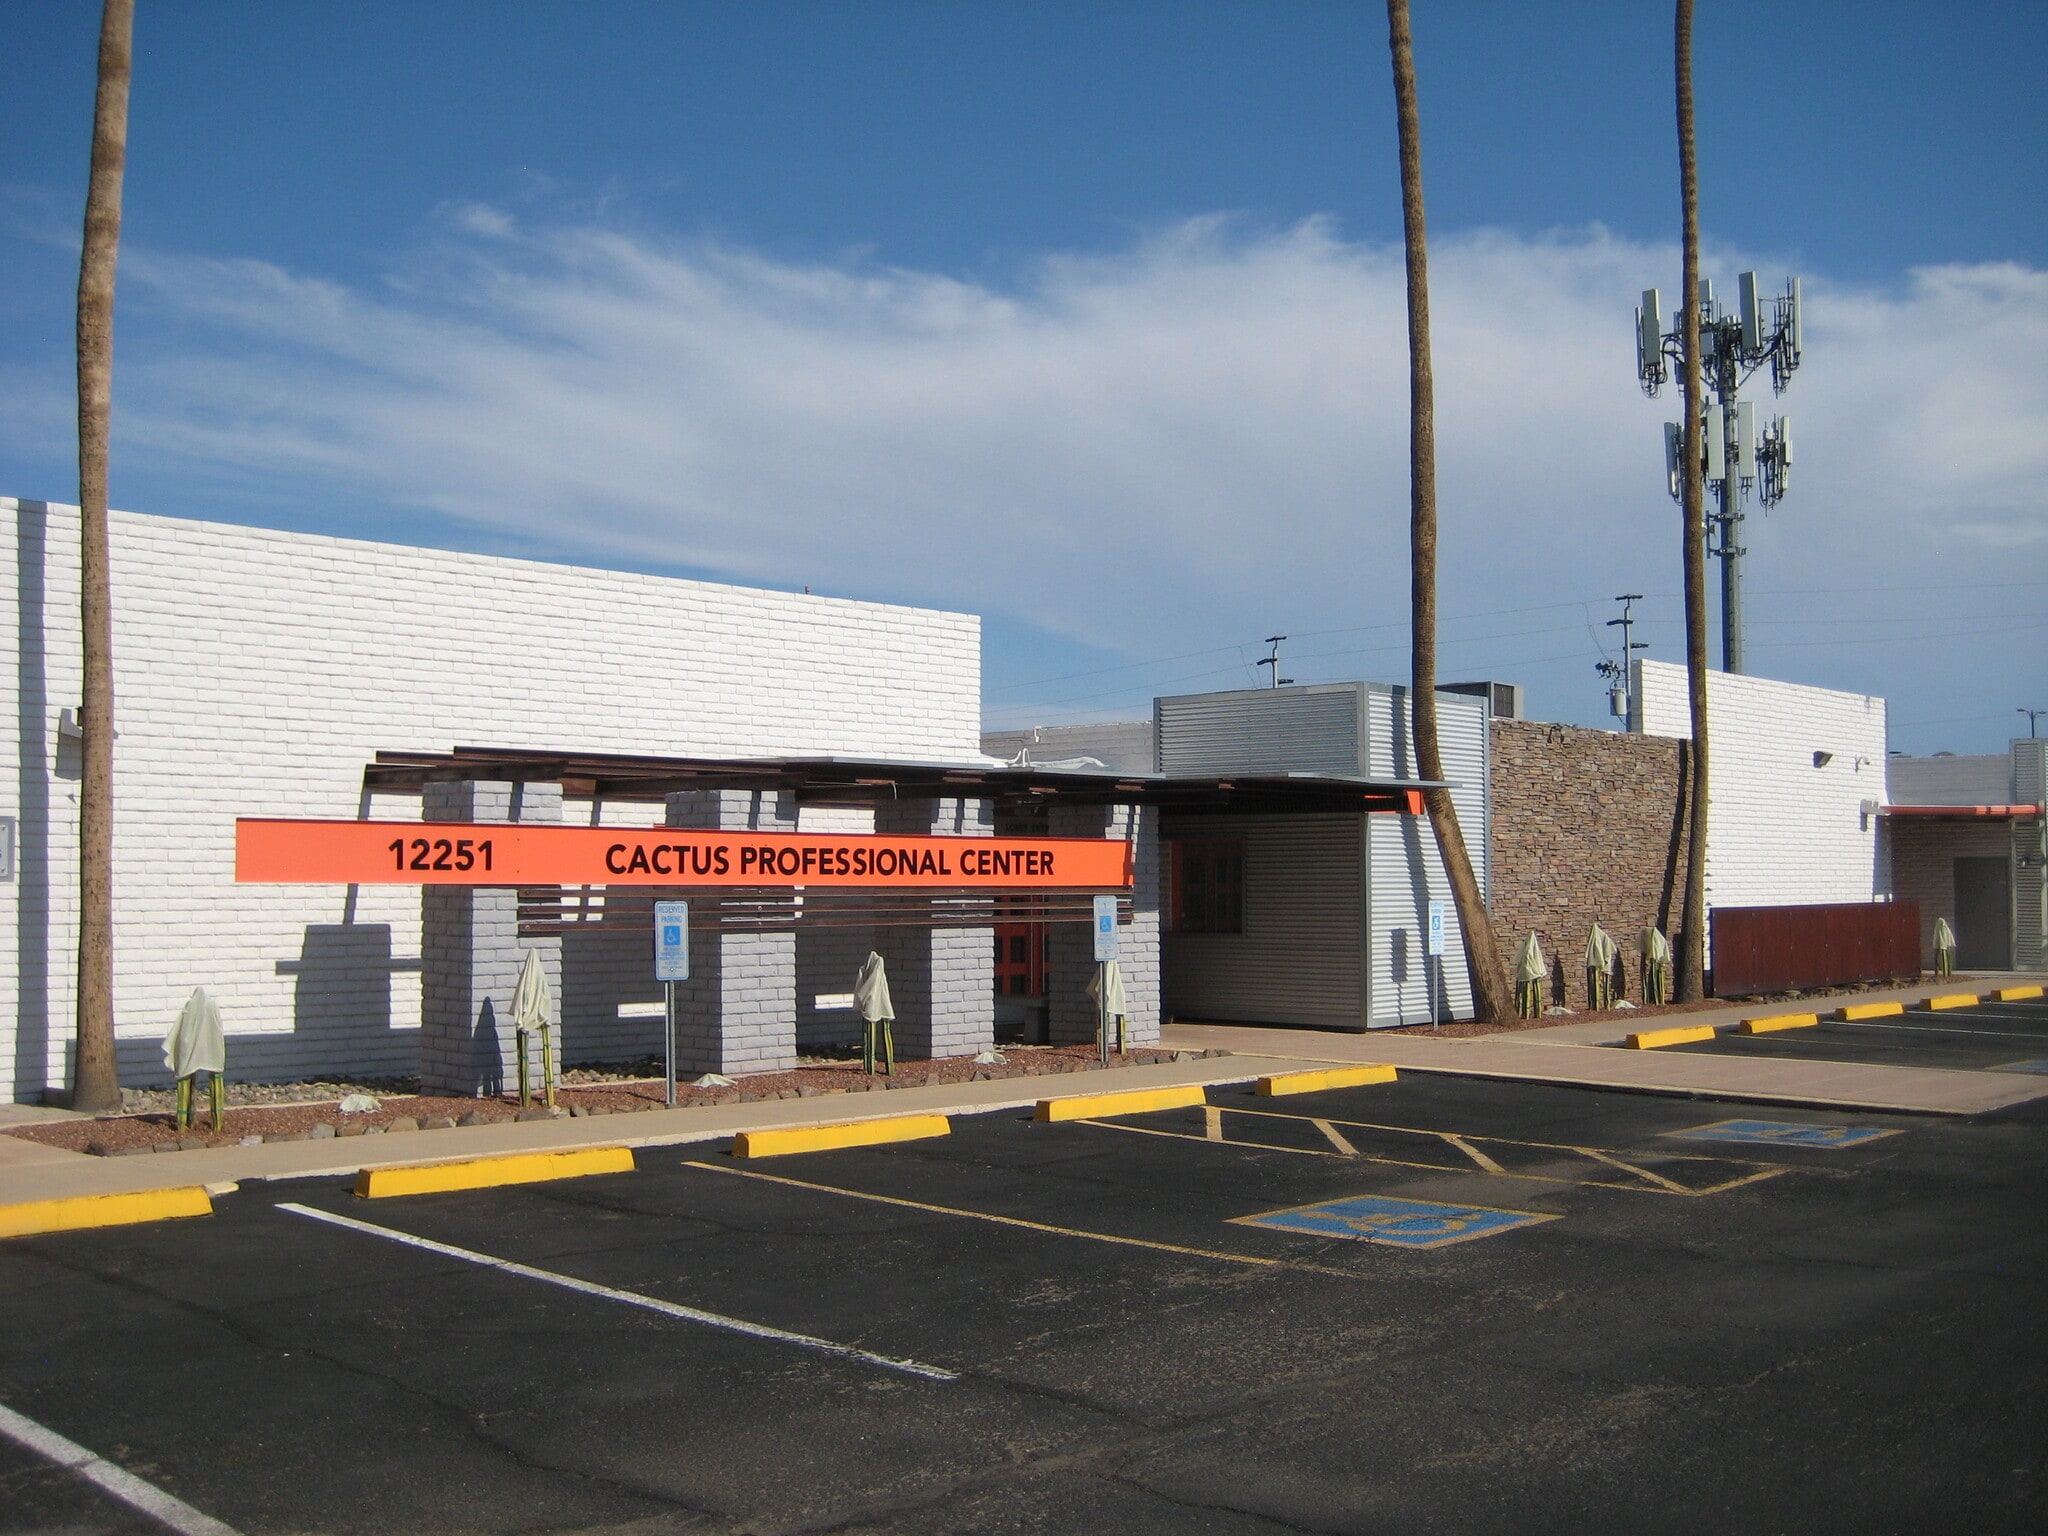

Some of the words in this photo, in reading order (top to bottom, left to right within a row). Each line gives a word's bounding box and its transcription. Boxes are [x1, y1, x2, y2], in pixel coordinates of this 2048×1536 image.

[388, 838, 492, 872] 12251
[605, 843, 730, 875] CACTUS
[740, 846, 952, 876] PROFESSIONAL
[959, 849, 1054, 876] CENTER
